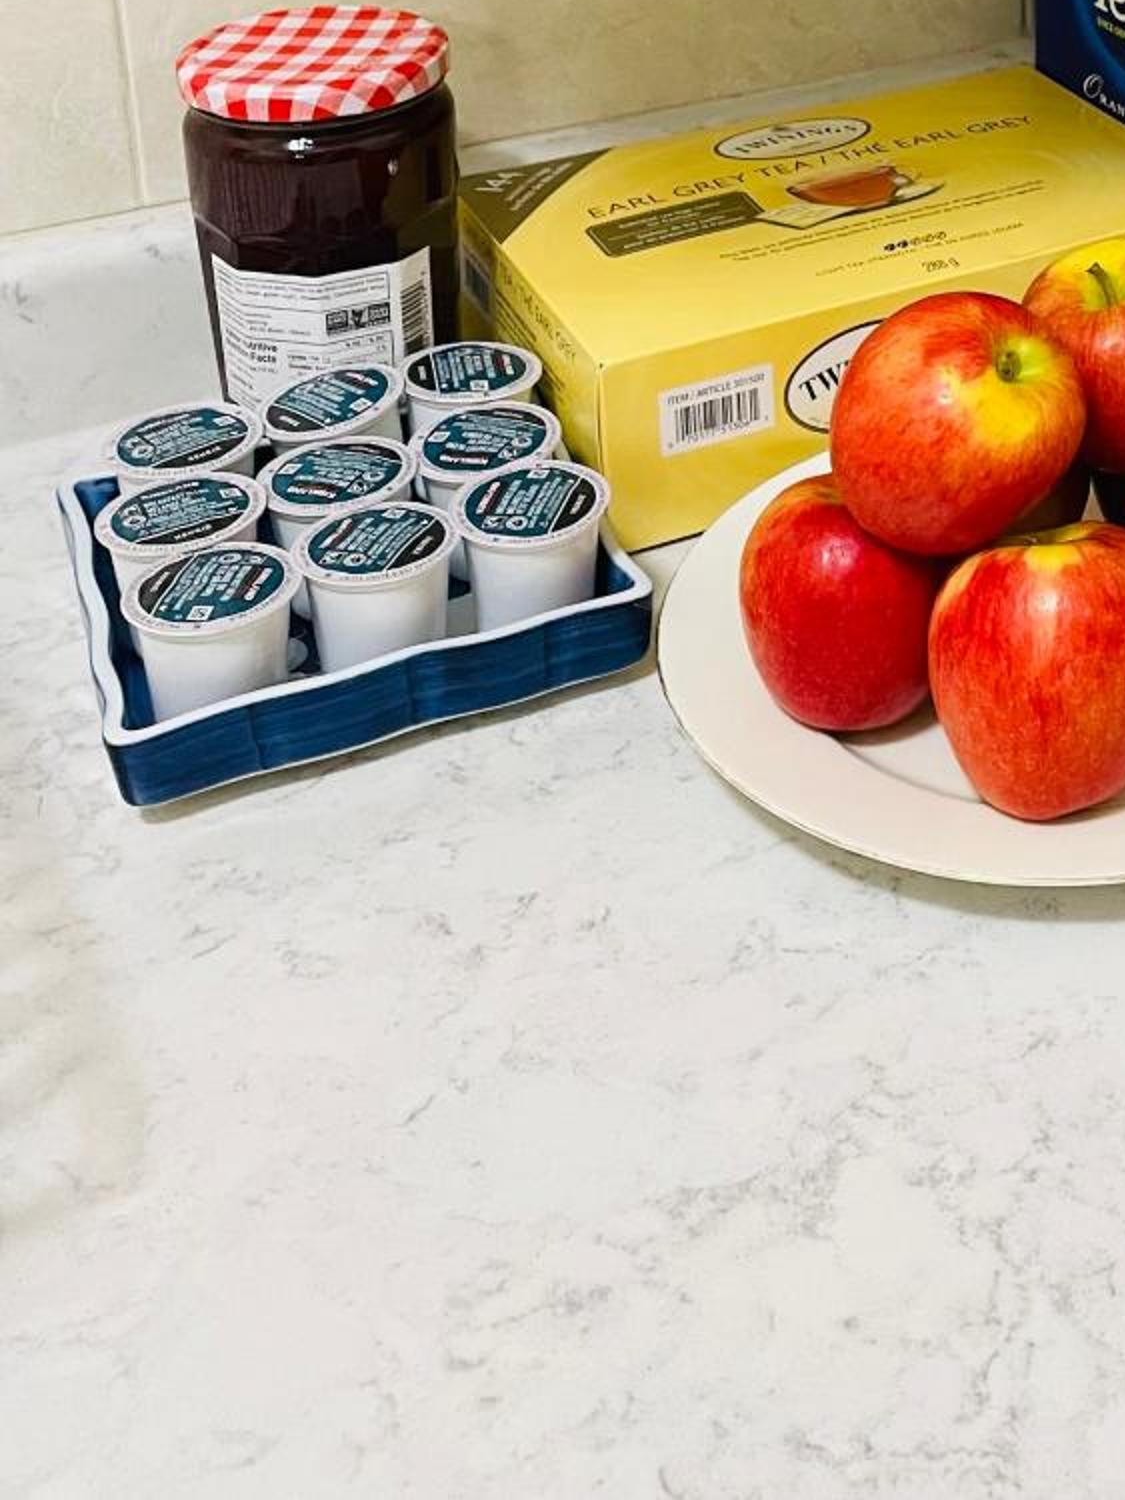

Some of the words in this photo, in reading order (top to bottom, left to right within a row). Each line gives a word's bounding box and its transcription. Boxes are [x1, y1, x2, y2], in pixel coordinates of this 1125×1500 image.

[587, 193, 669, 219] EARL
[672, 171, 746, 198] GREY
[754, 156, 811, 178] TEA
[895, 129, 959, 150] EARL
[967, 114, 1033, 135] GREY
